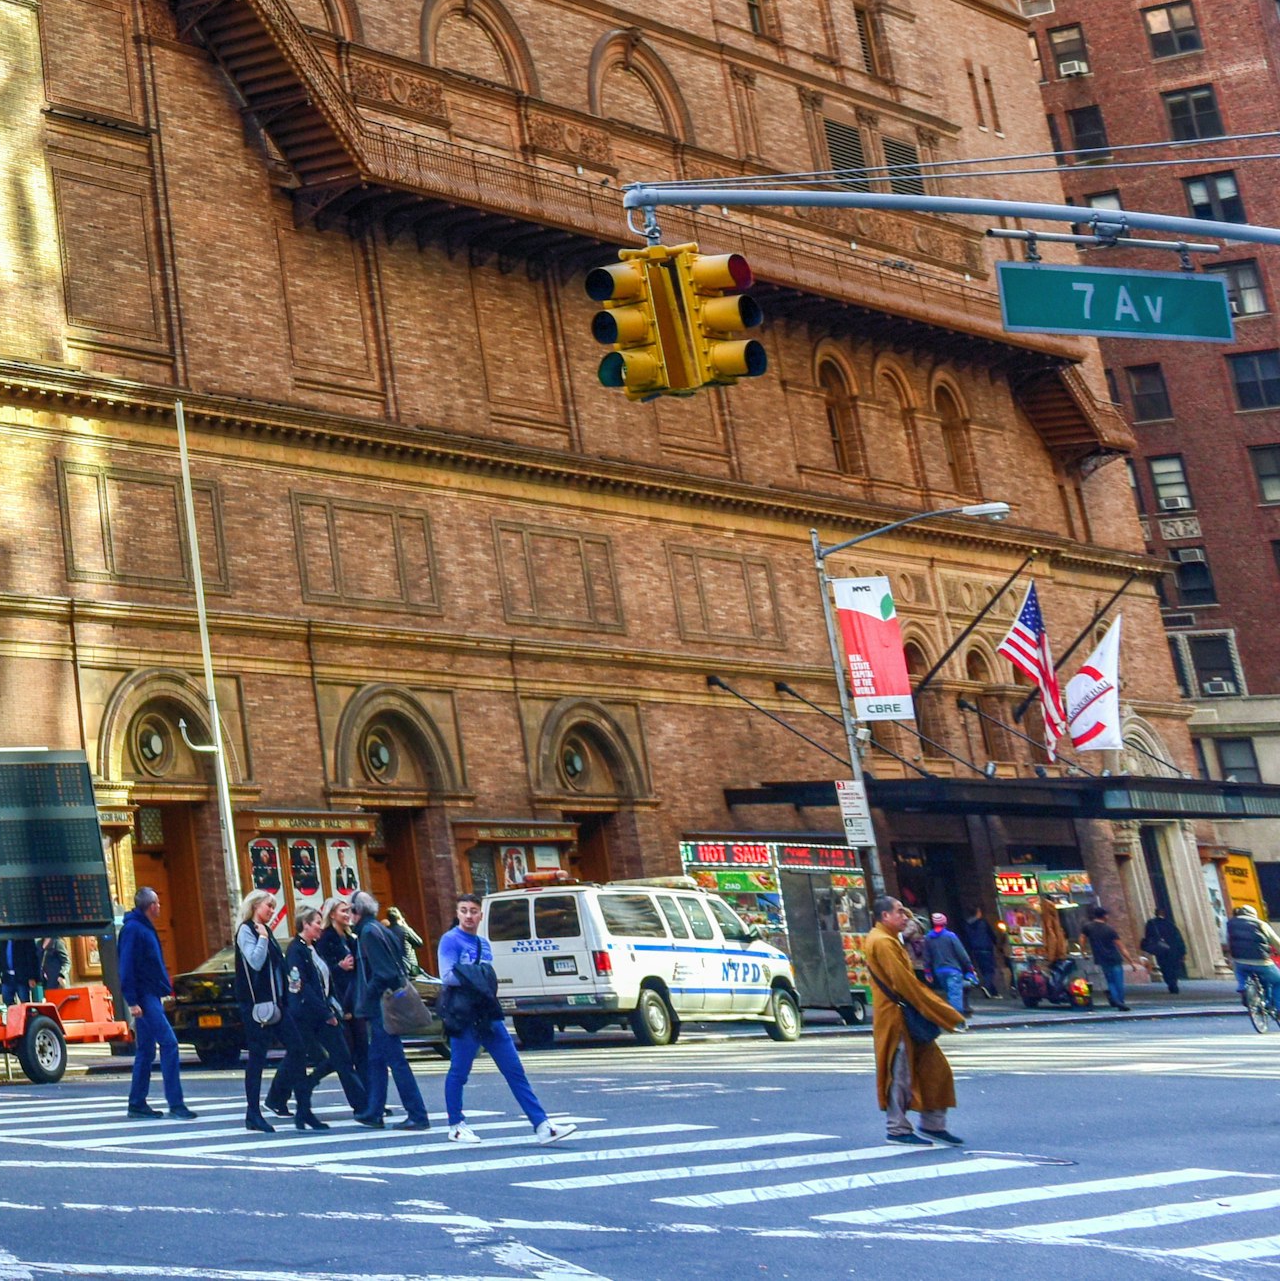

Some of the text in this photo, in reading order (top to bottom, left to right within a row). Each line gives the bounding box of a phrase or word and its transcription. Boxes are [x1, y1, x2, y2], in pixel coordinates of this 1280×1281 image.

[1072, 282, 1095, 319] 7
[1090, 679, 1111, 698] HALL
[867, 703, 901, 714] CBRE
[698, 845, 726, 862] HOT
[512, 944, 560, 953] POLICE
[517, 939, 553, 947] NYPD
[721, 962, 761, 983] NYPD
